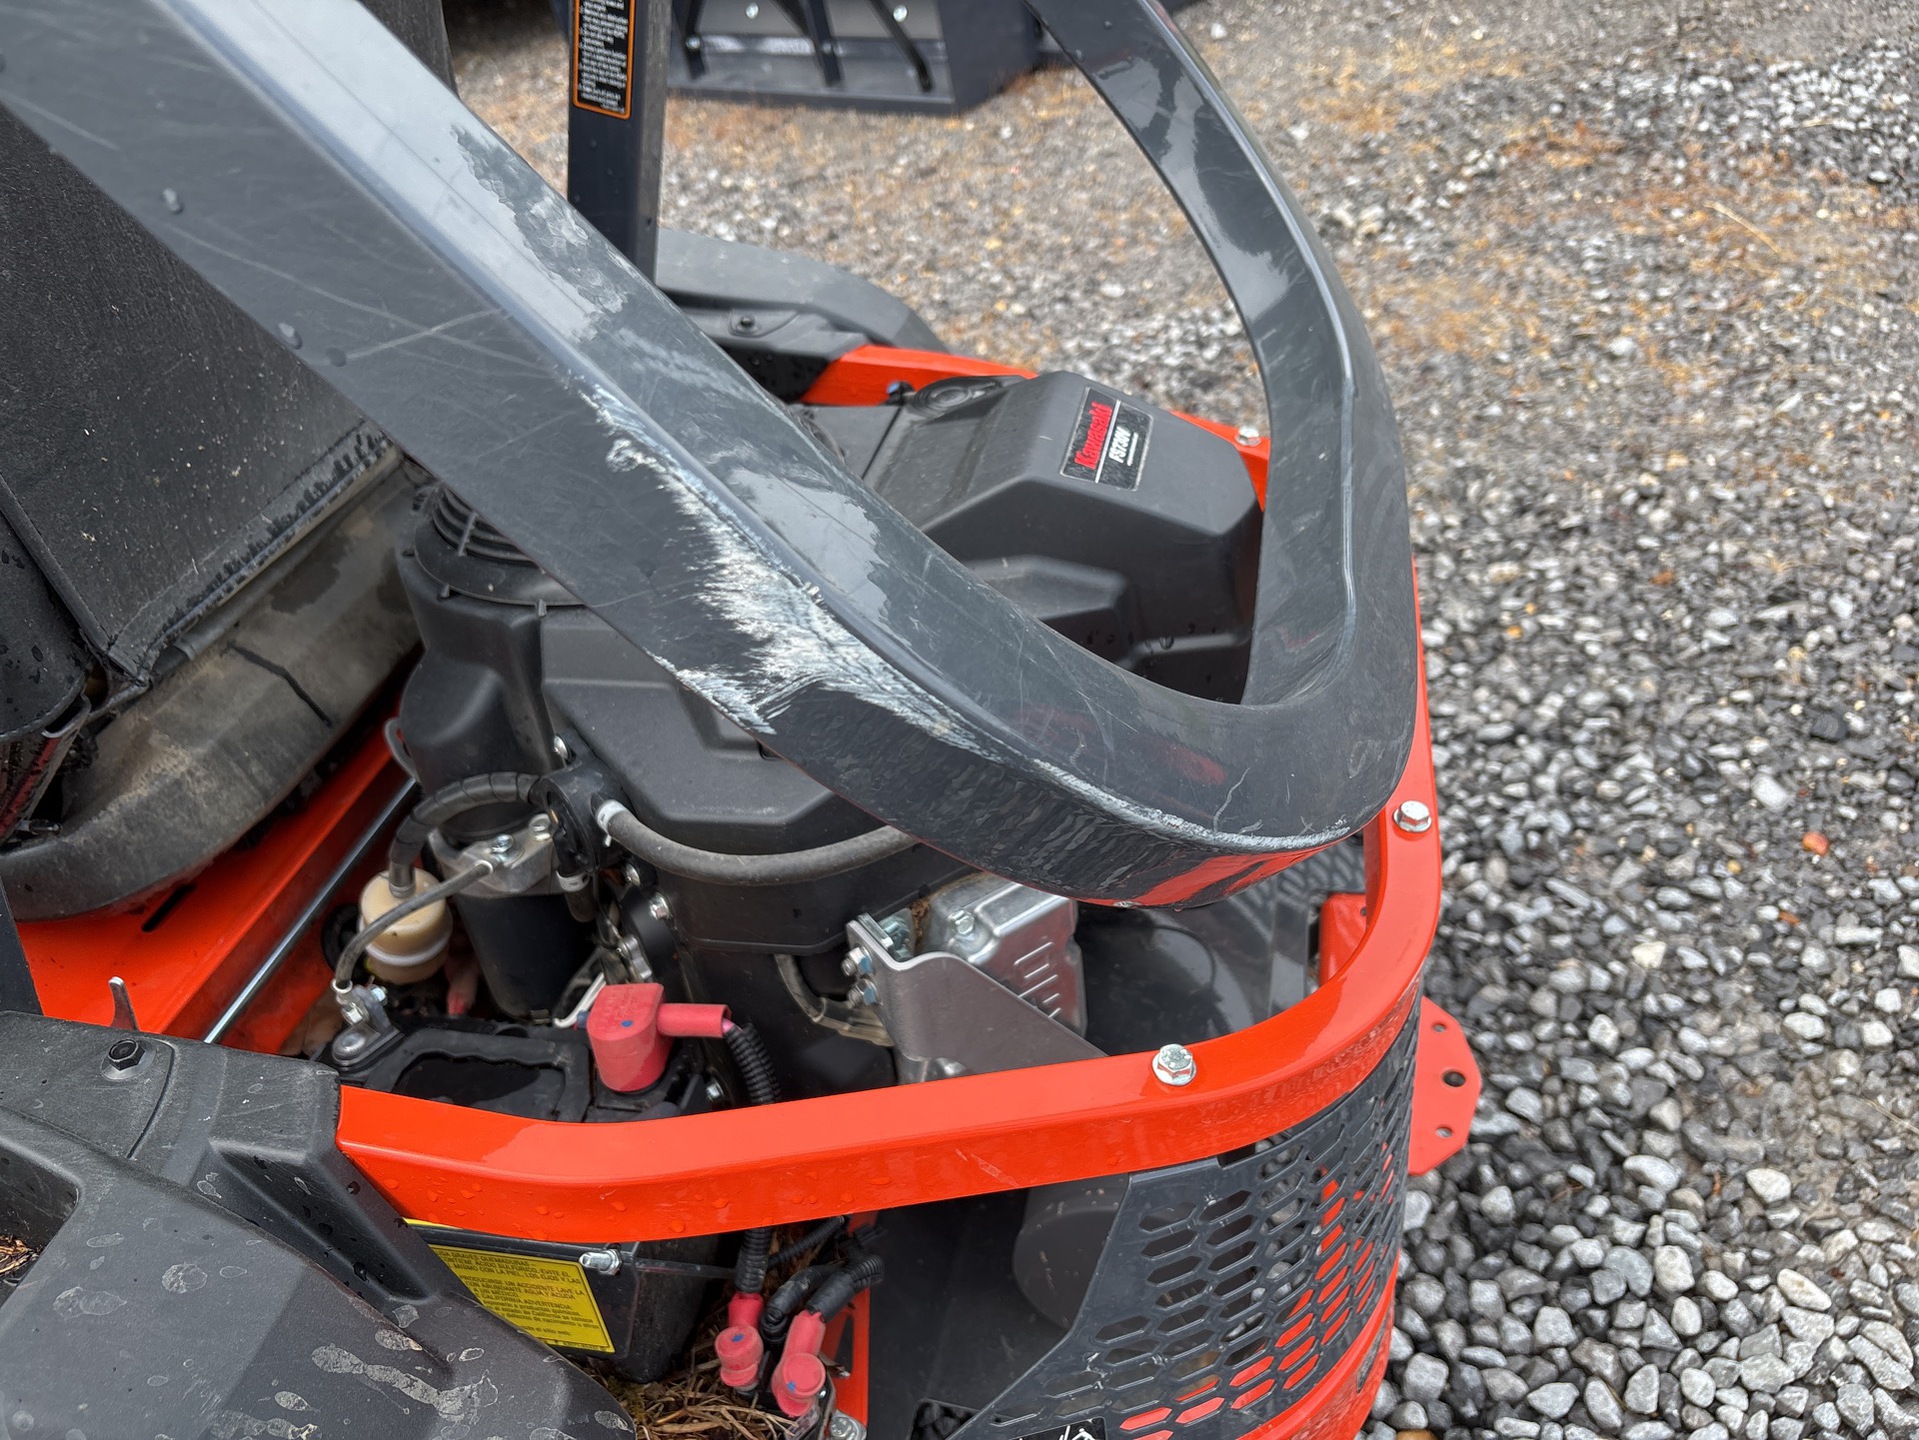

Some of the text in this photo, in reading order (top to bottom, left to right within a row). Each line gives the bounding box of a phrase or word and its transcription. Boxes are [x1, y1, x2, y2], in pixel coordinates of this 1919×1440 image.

[1073, 401, 1113, 470] Kawasaki
[1108, 426, 1132, 464] FS730V
[450, 1251, 479, 1260] GRAVES
[453, 1262, 478, 1270] MISMO
[480, 1282, 521, 1292] ABUNDANTE
[523, 1287, 544, 1295] AGUA
[550, 1291, 575, 1299] ACUDA
[516, 1281, 554, 1291] ACCIDENTE
[480, 1292, 523, 1303] CALIFORNIA
